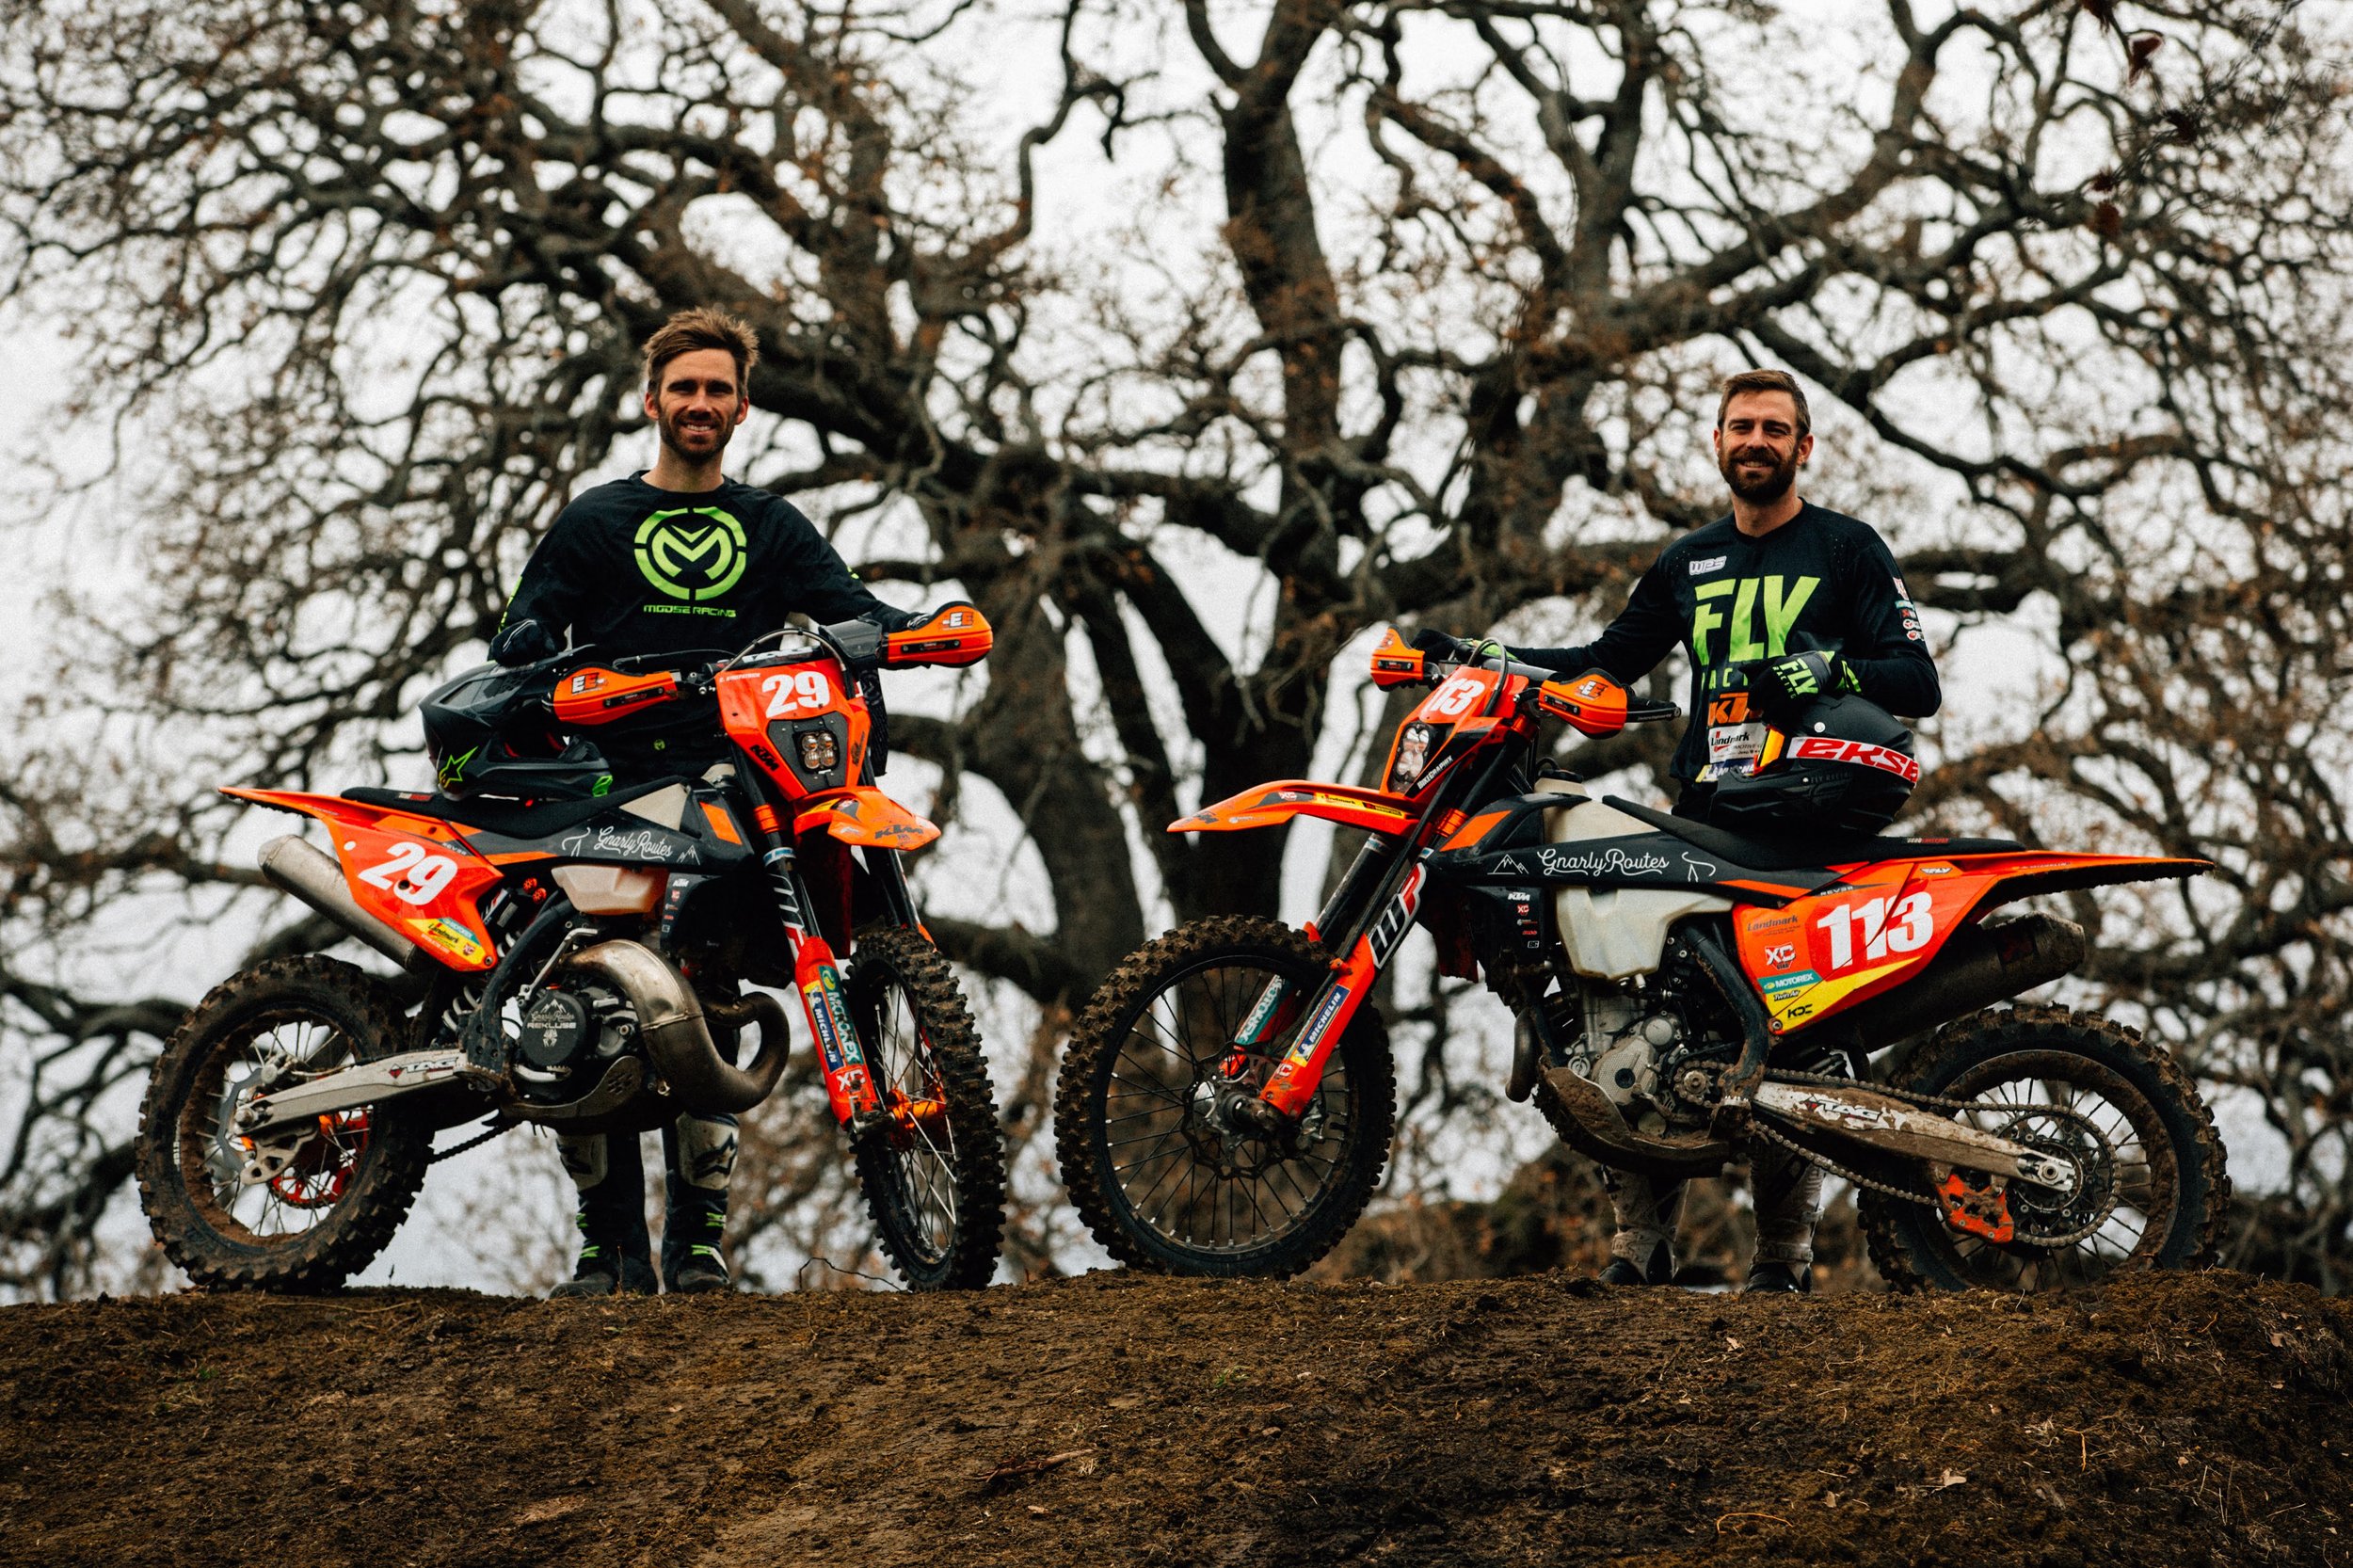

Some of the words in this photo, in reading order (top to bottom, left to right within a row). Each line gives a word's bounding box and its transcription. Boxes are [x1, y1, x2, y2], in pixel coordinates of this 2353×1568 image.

[644, 605, 691, 615] MOOSE
[693, 607, 737, 618] RACING
[1693, 575, 1821, 666] FLY
[761, 671, 830, 718] 29
[1779, 658, 1819, 696] FLY
[1707, 692, 1751, 728] KT
[358, 841, 458, 905] 29
[1508, 891, 1531, 901] KTM
[1747, 915, 1799, 932] Landmark
[1817, 891, 1934, 970] 113
[1765, 944, 1796, 966] XC
[1774, 972, 1815, 988] MOTOREX
[1308, 992, 1342, 1043] MICHELIN
[1817, 1099, 1883, 1122] TAG
